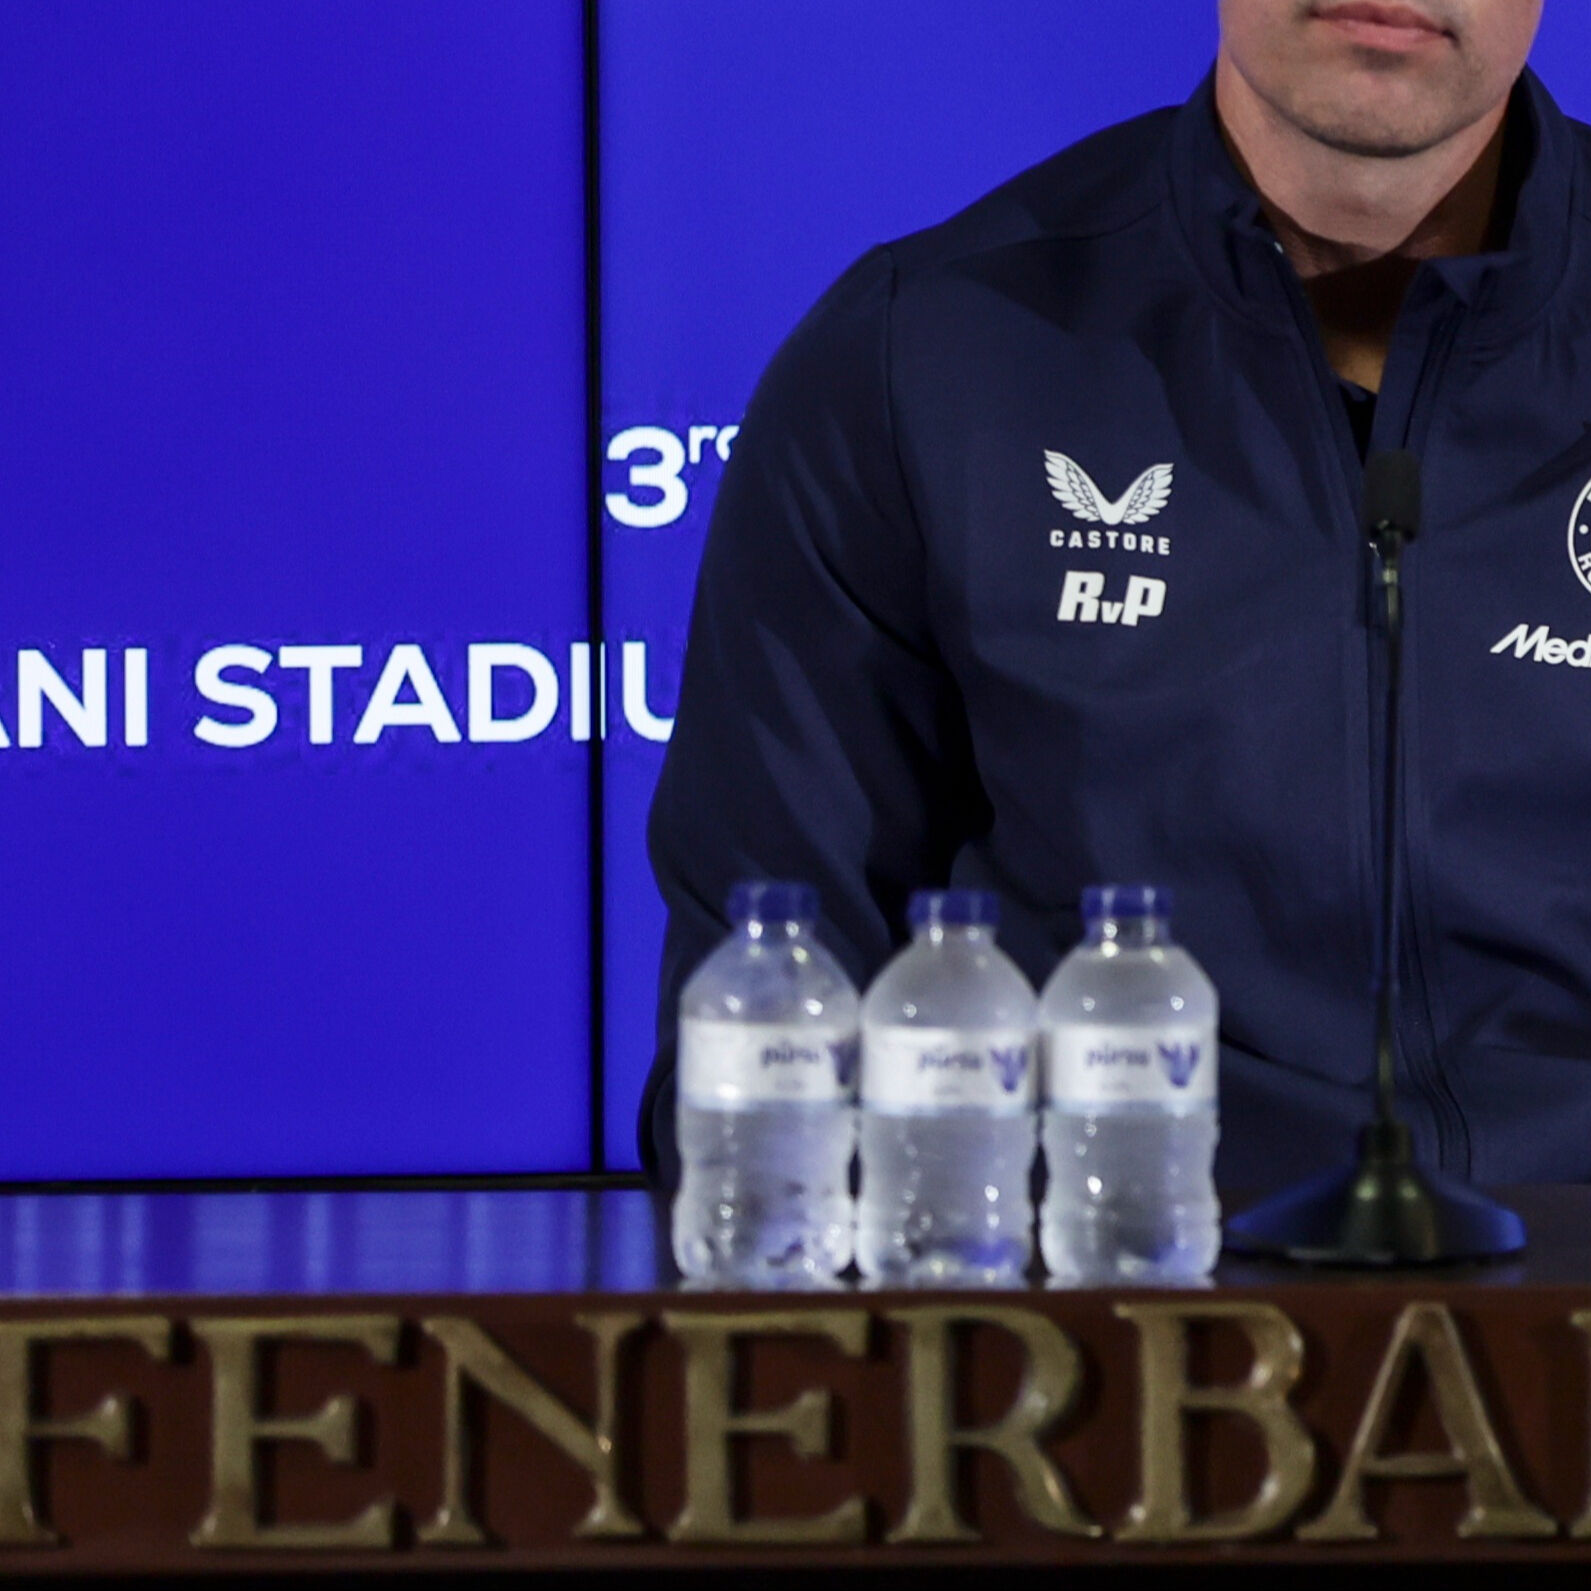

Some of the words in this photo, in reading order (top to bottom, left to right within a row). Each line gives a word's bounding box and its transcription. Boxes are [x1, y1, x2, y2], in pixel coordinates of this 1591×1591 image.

[1050, 529, 1171, 556] CASTORE
[1056, 570, 1167, 627] RvP
[0, 646, 149, 749] NI
